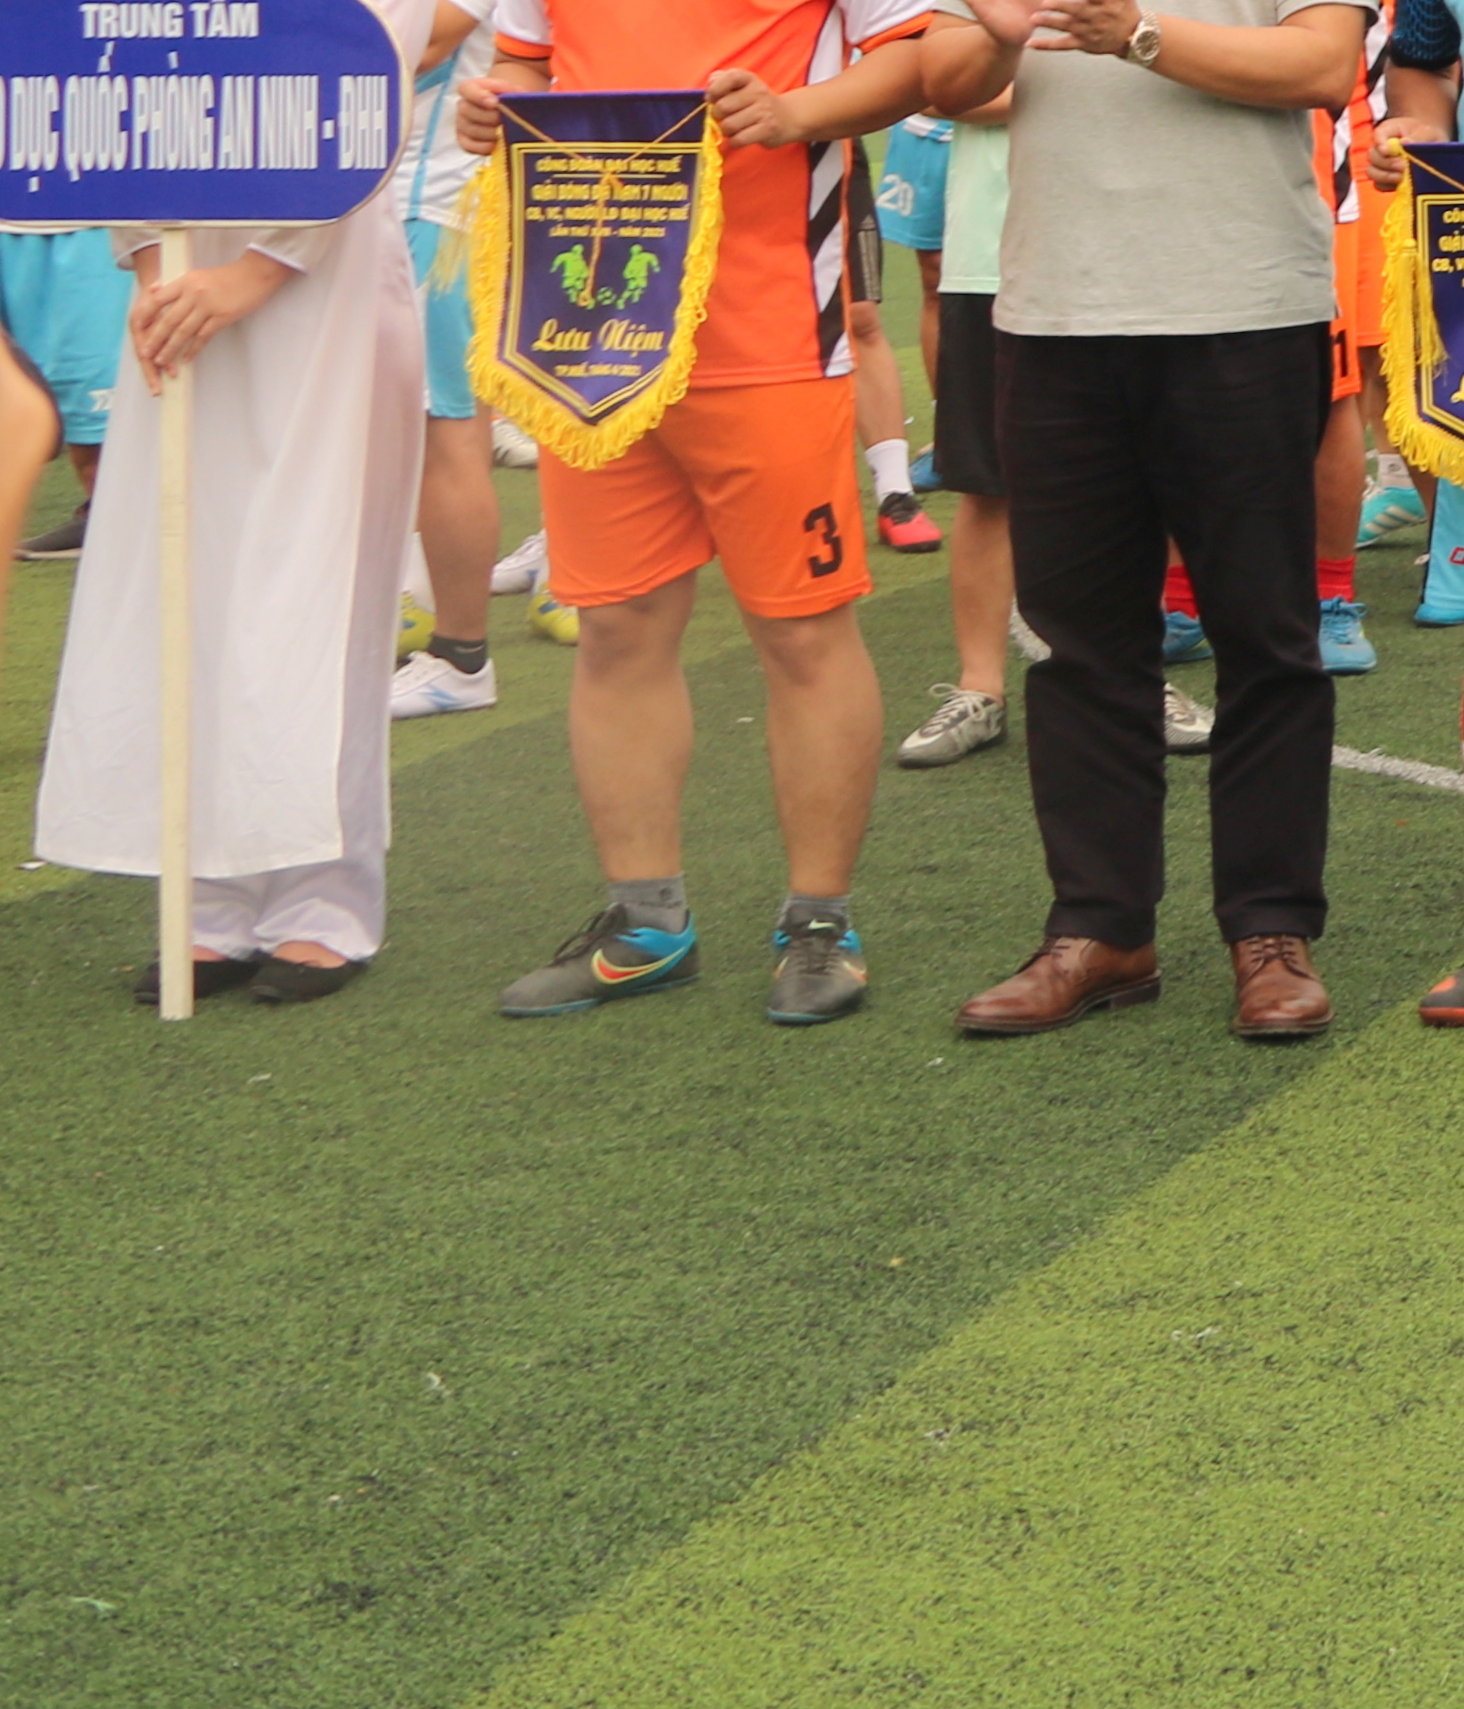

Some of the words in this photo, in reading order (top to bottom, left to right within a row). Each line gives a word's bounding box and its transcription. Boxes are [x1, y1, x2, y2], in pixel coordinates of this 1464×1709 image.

[79, 2, 183, 38] TRUNG
[9, 75, 59, 192] DỤC
[64, 41, 128, 182] QUỐC
[132, 50, 214, 170] PHÒNG
[218, 75, 254, 170] AN
[259, 75, 318, 170] NINH
[339, 75, 388, 170] ĐHH
[875, 174, 915, 217] 20
[531, 318, 592, 351] Lưu
[597, 318, 664, 357] Niệm
[804, 502, 843, 578] 3
